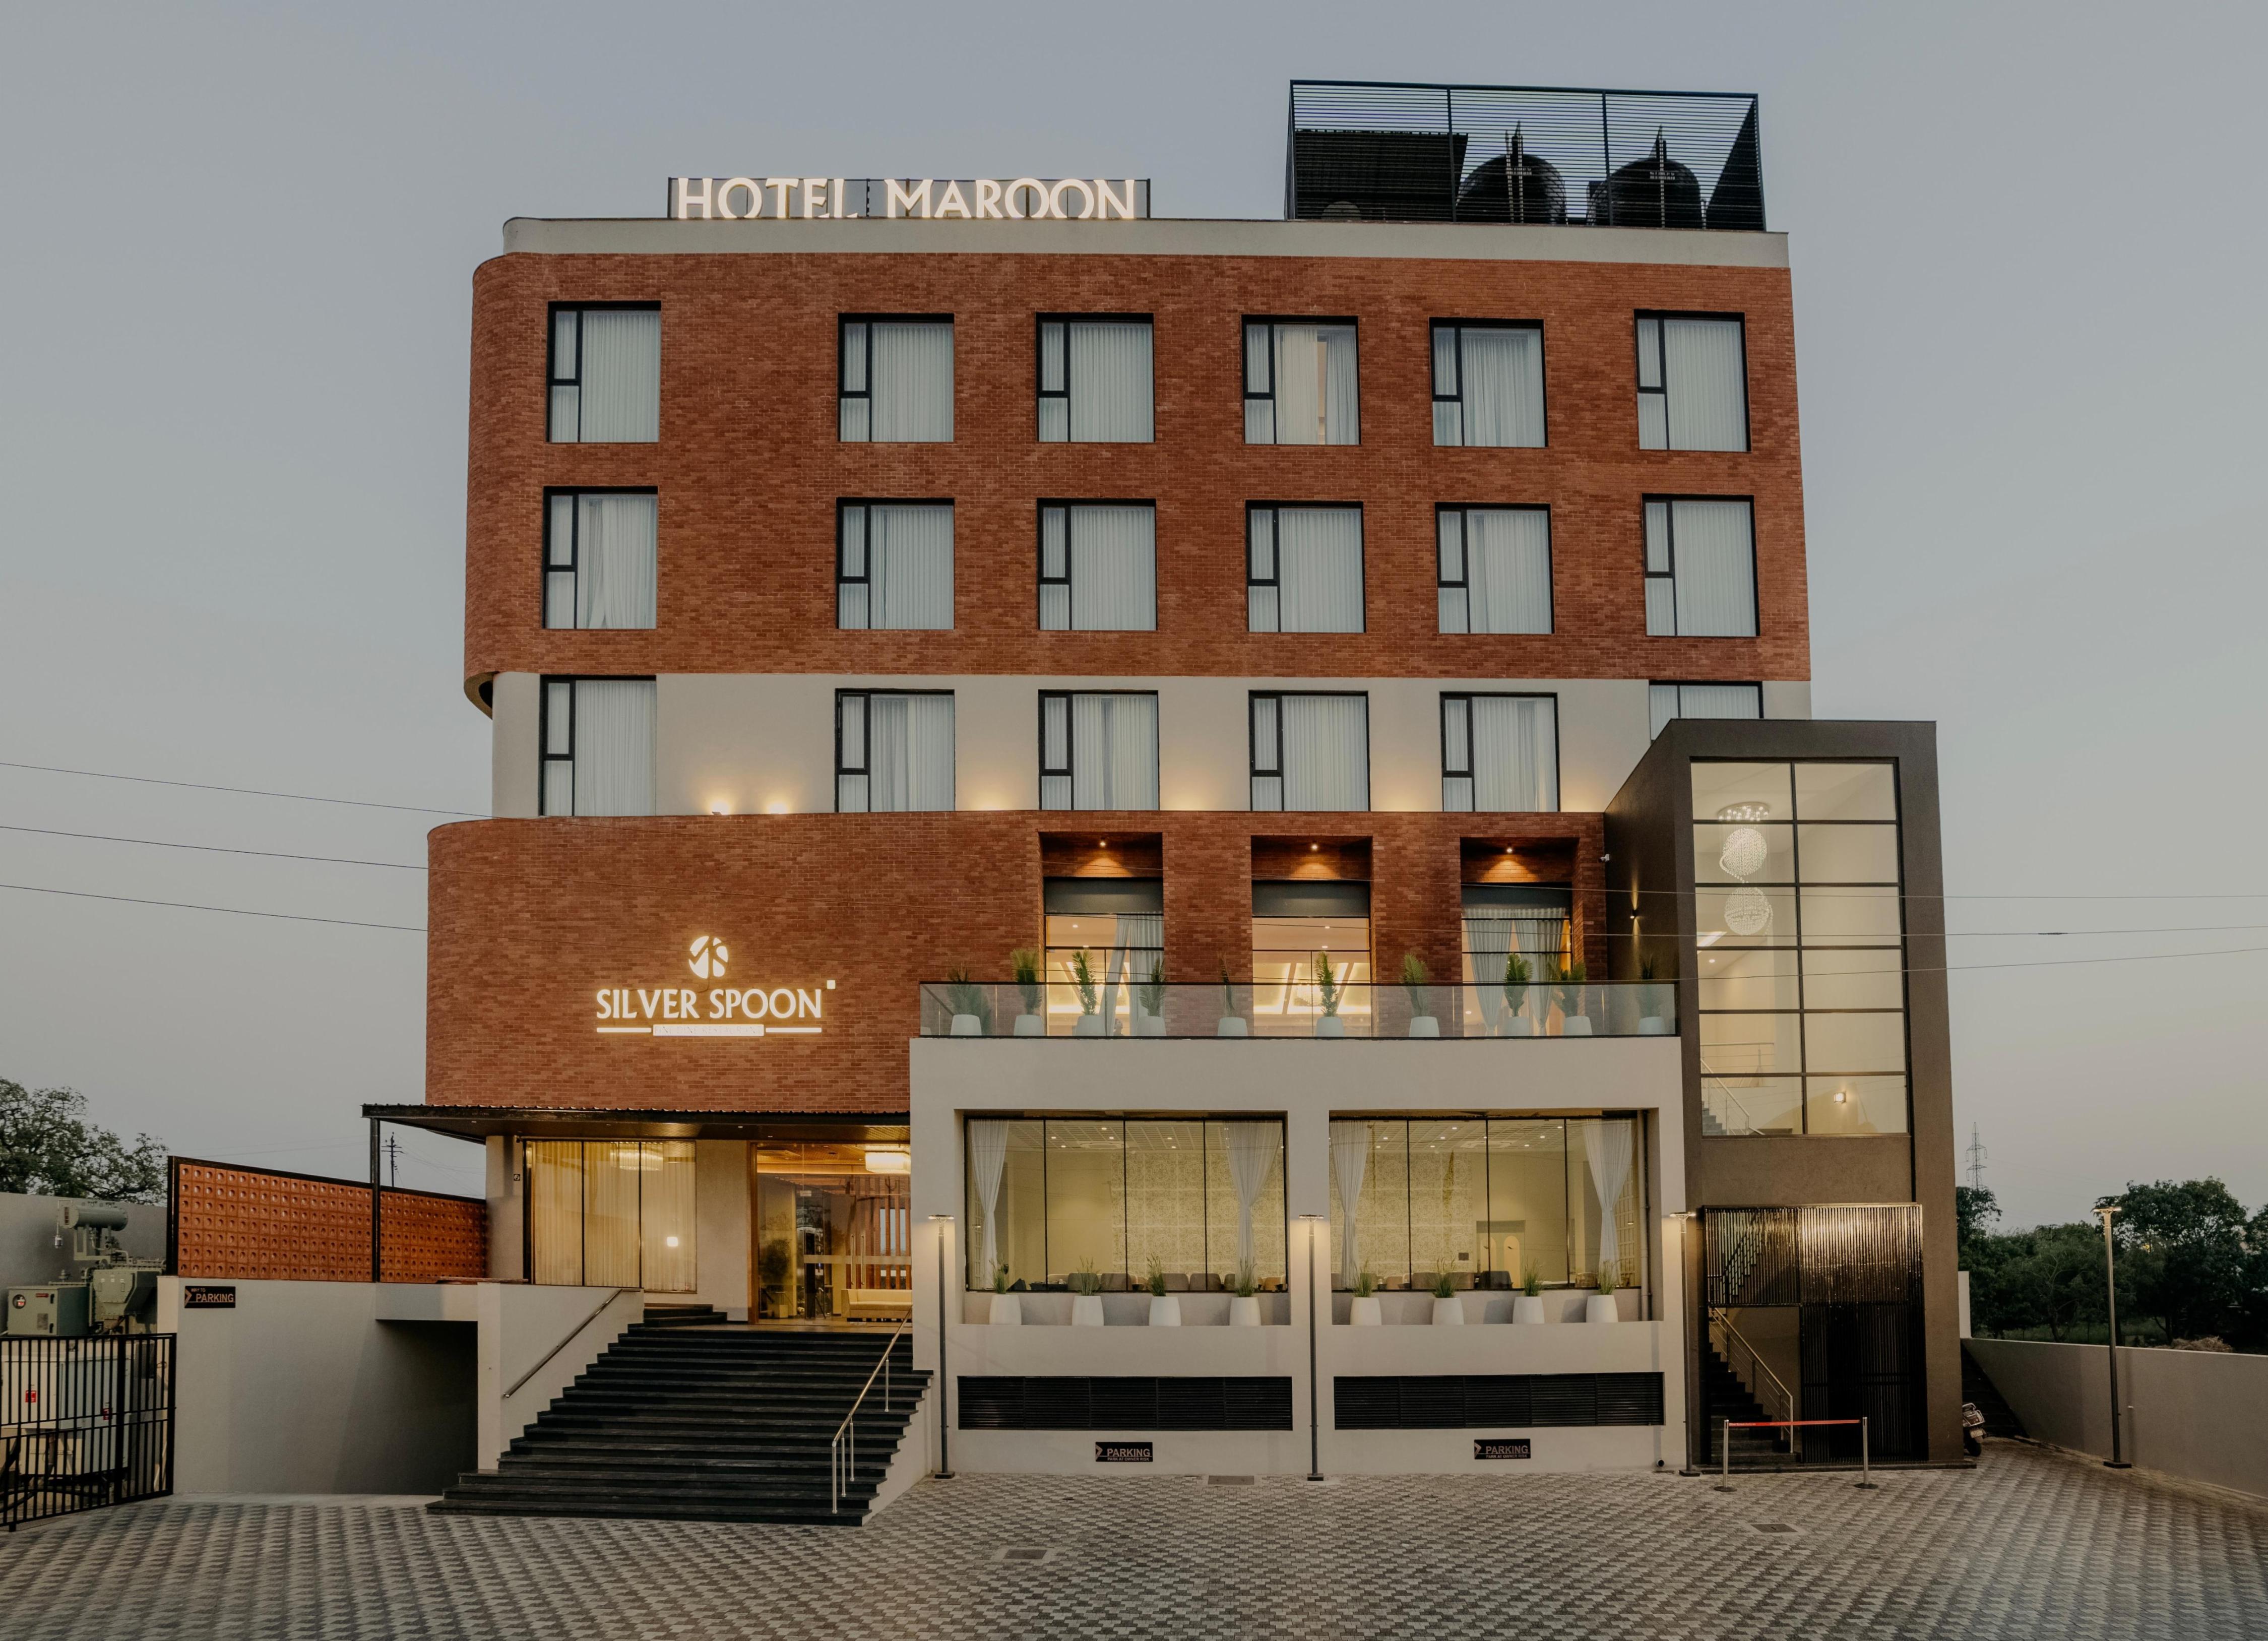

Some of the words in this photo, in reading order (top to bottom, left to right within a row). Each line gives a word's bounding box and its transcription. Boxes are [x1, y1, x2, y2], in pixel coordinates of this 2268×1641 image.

[677, 177, 858, 218] HOTEL
[885, 178, 1135, 219] MAROON
[596, 989, 700, 1019] SILVER
[710, 988, 822, 1019] SPOON
[196, 1293, 234, 1303] PARKING
[1107, 1448, 1150, 1457] PARKING
[1485, 1445, 1528, 1454] PARKING
